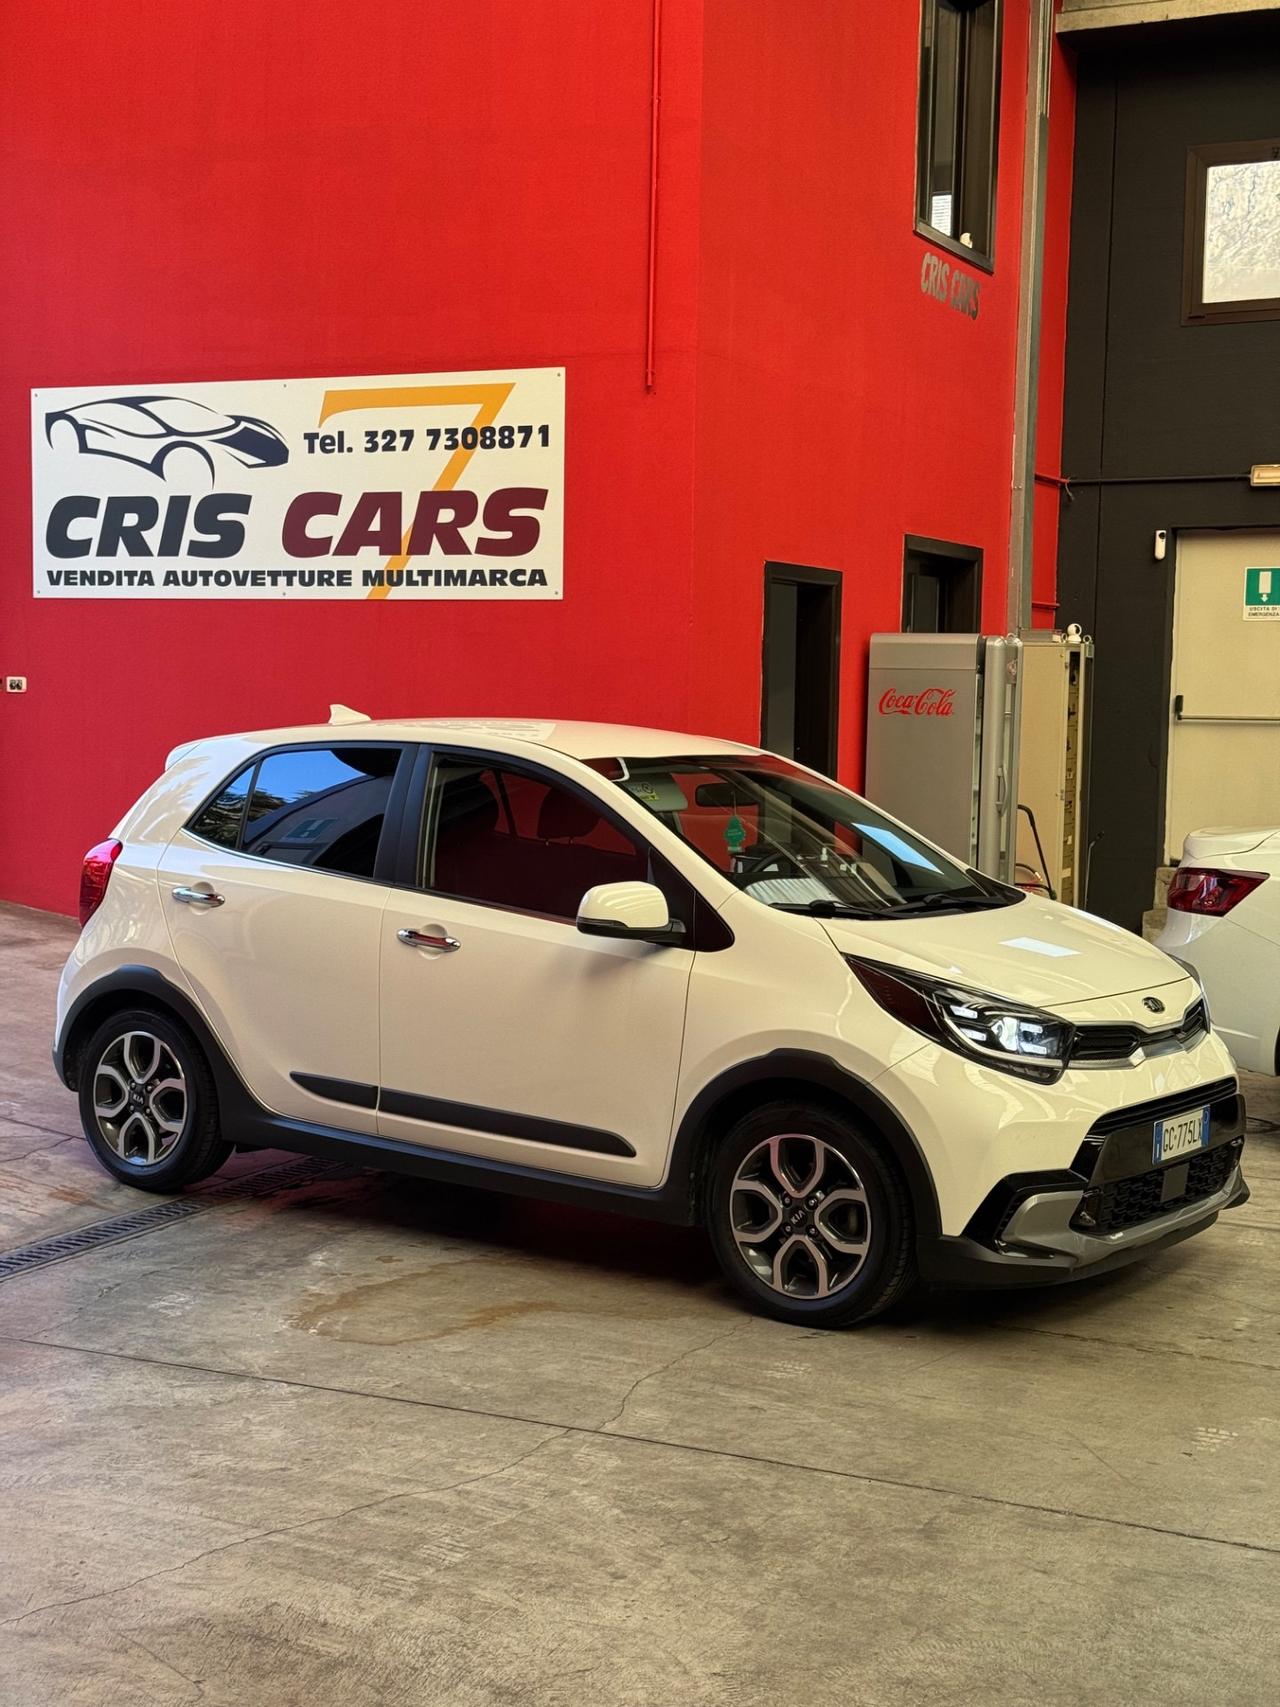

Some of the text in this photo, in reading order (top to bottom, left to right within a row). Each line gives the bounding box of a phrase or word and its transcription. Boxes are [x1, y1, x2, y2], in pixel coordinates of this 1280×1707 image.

[921, 252, 980, 320] CRIS CARS
[304, 425, 549, 454] Tel. 327 7308871
[46, 488, 548, 558] CRIS CARS
[47, 569, 547, 586] VENDITA AUTOVETTURE MULTIMARCA
[790, 1210, 806, 1225] KIA
